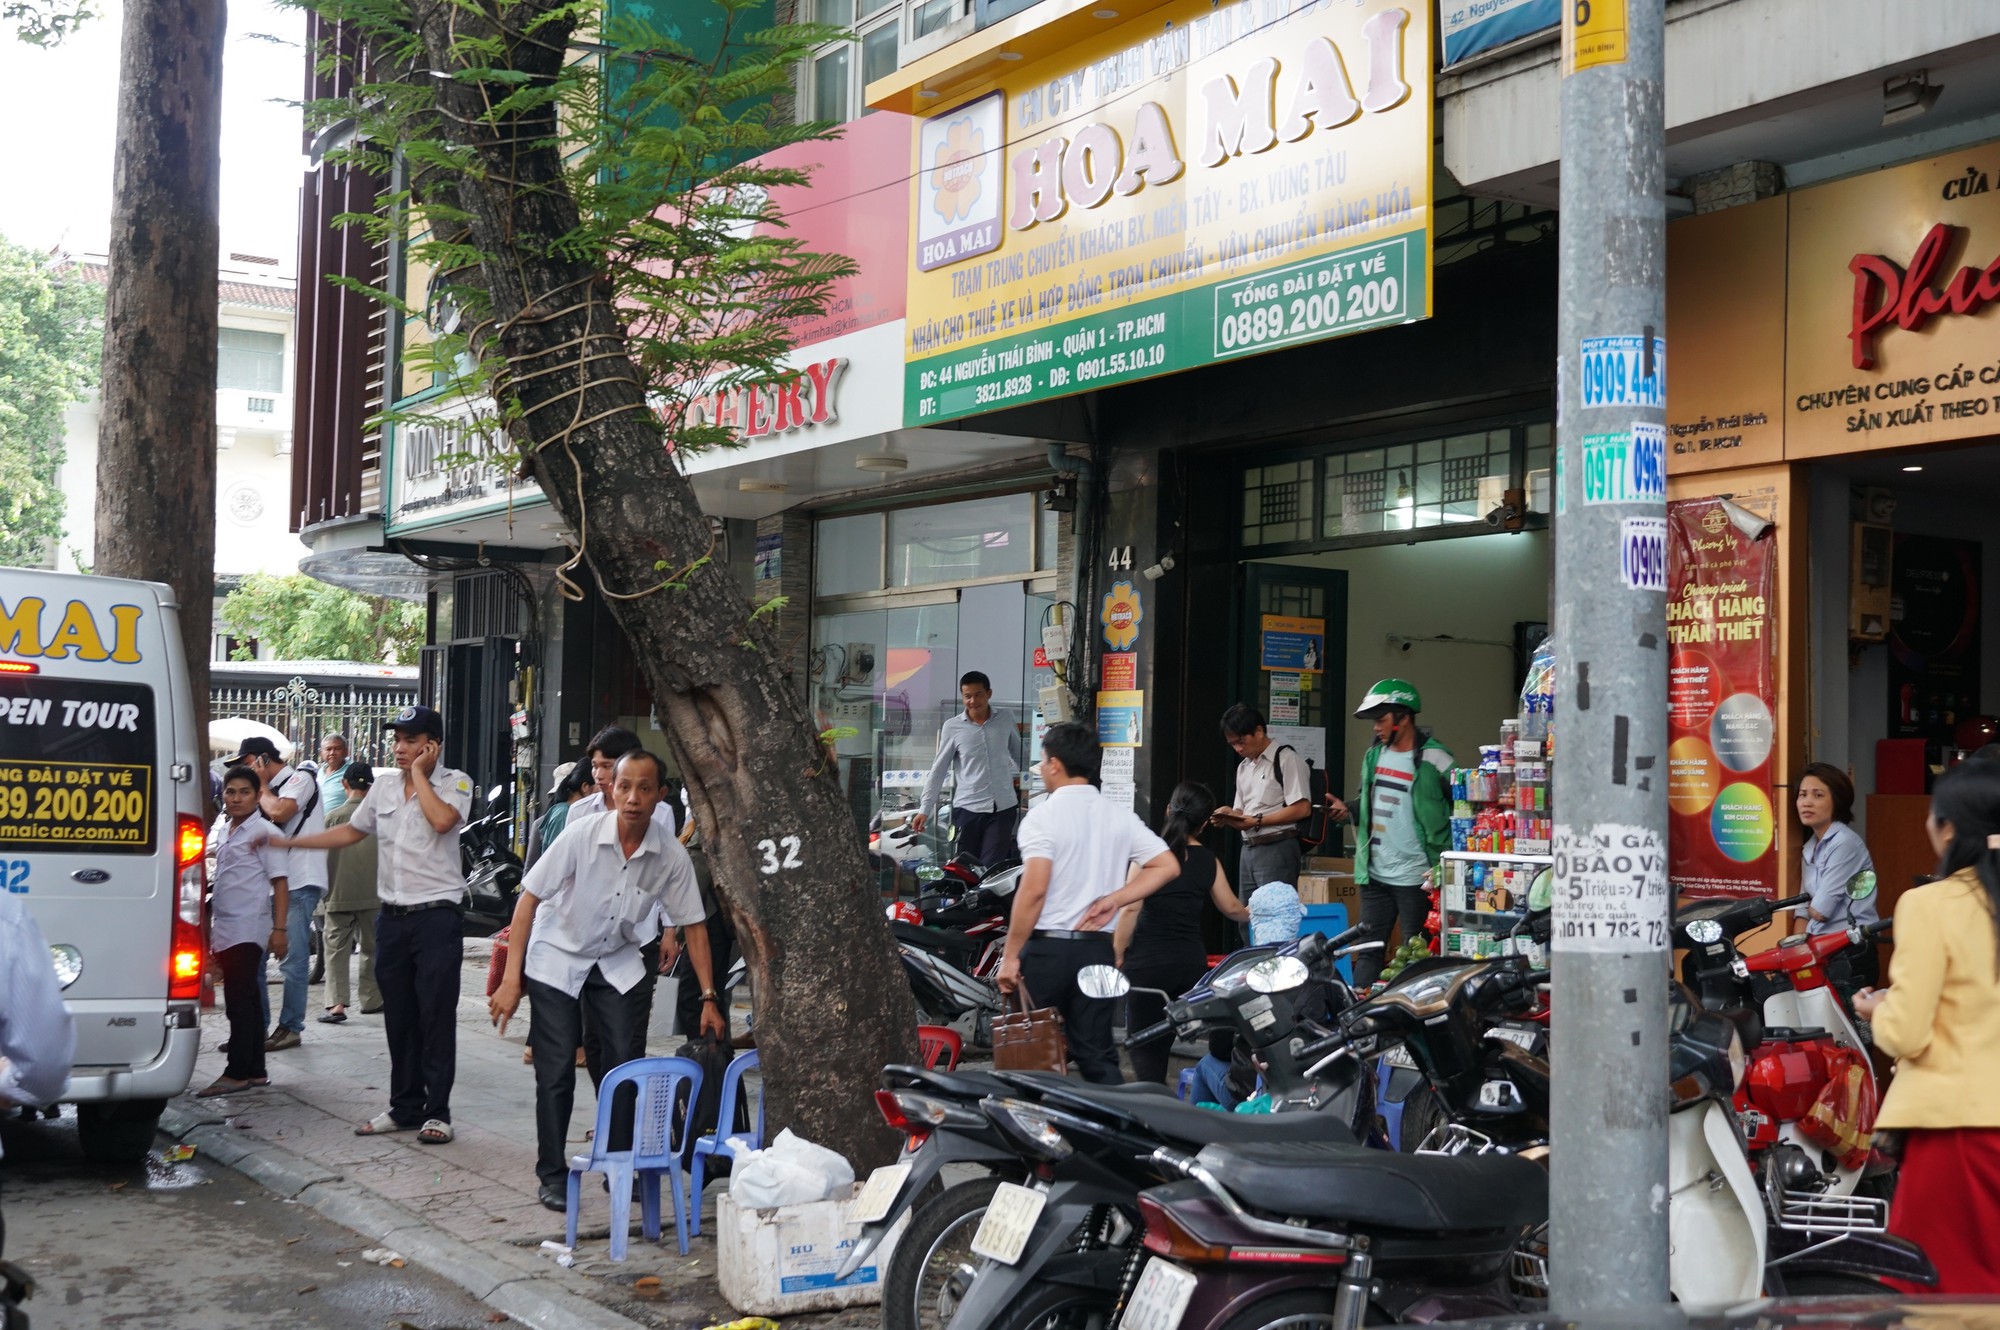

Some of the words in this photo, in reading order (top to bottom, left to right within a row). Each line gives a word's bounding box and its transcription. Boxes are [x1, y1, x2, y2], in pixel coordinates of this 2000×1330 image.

[1450, 10, 1465, 26] 42
[1018, 86, 1043, 129] CN
[1049, 66, 1087, 118] CTY
[1091, 45, 1145, 97] TNHH
[1149, 20, 1191, 82] VẬN
[1010, 101, 1184, 232] HOA
[1199, 8, 1411, 169] MAI
[1942, 167, 1990, 200] CỬA
[952, 265, 983, 301] TRẠM
[987, 252, 1024, 288] TRUNG
[1027, 225, 1075, 277] CHUYỂN
[1080, 219, 1124, 261] KHÁCH
[1194, 187, 1222, 227] TÂY
[1240, 180, 1265, 214] BX.
[1267, 162, 1309, 203] VŨNG
[1314, 148, 1347, 188] TÀU
[923, 238, 956, 266] HOA
[961, 225, 993, 254] MAI
[912, 319, 940, 356] NHẬN
[942, 314, 964, 344] CHO
[968, 300, 996, 338] THUÊ
[1000, 300, 1015, 330] XE
[1018, 288, 1033, 324] VÀ
[1039, 283, 1063, 323] HỢP
[1068, 268, 1102, 311] ĐỒNG
[1108, 263, 1144, 303] TRỌN
[1150, 237, 1203, 290] CHUYẾN
[1218, 229, 1251, 275] VẬN
[1254, 200, 1318, 264] CHUYỂN
[1324, 197, 1371, 240] HÀNG
[1376, 180, 1413, 228] HÓA
[1232, 281, 1278, 307] TỔNG
[1283, 274, 1312, 297] ĐÀI
[1318, 262, 1356, 288] ĐẶT
[1361, 252, 1386, 276] VÉ
[831, 299, 853, 316] HCM
[1221, 276, 1399, 349] 0889.200.200
[920, 369, 937, 390] ĐC:
[940, 365, 953, 386] 44
[954, 347, 995, 383] NGUYỄN
[998, 342, 1024, 372] THÁI
[1027, 339, 1053, 364] BÌNH
[1063, 327, 1095, 356] QUẬN
[1099, 328, 1106, 348] 1
[1117, 312, 1166, 343] TP.HCM
[919, 397, 936, 417] ĐT:
[975, 374, 1033, 405] 3821.8928
[1050, 366, 1071, 389] DĐ:
[1076, 343, 1165, 383] 0901.55.10.10
[1797, 384, 1870, 411] CHUYÊN
[1875, 377, 1930, 399] CUNG
[1934, 363, 1974, 390] CẤP
[1847, 409, 1882, 432] SẢN
[1887, 399, 1933, 427] XUẤT
[1941, 398, 1988, 419] THEO
[1109, 545, 1132, 571] 44
[1725, 534, 1738, 550] Vy
[1719, 594, 1765, 618] HÀNG
[1668, 621, 1711, 643] THÂN
[1716, 616, 1763, 640] THIẾT
[62, 700, 140, 732] TOUR
[28, 765, 61, 784] ĐÀI
[65, 769, 104, 788] ĐẶT
[109, 768, 133, 786] VÉ
[757, 835, 803, 874] 32
[1336, 886, 1356, 897] LED
[107, 1017, 137, 1027] ABS
